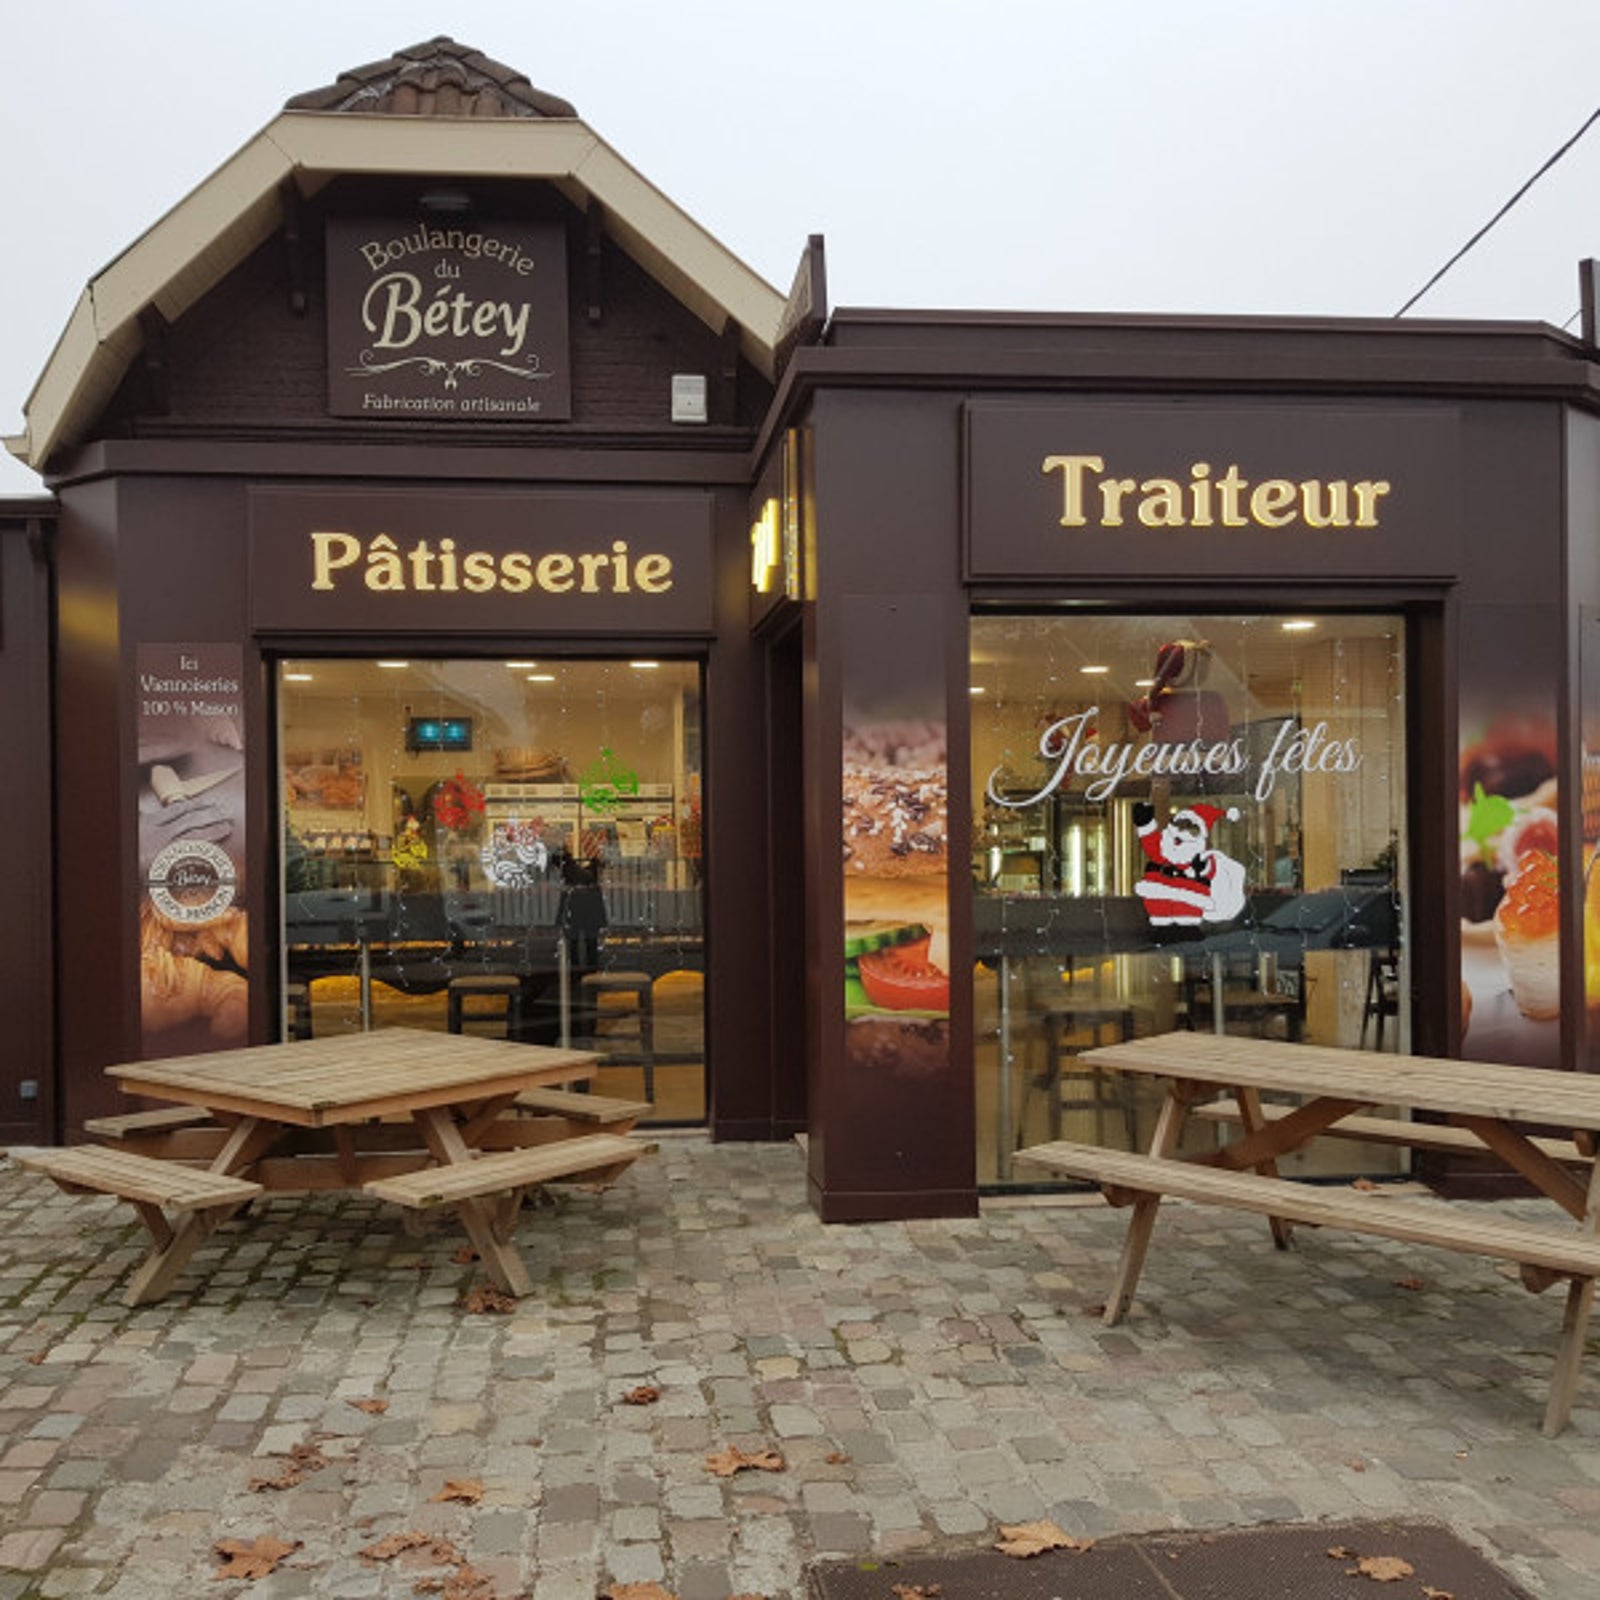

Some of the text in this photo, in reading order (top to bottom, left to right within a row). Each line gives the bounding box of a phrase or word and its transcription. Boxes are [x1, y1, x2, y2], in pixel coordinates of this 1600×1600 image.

[360, 223, 535, 276] Boulangerie
[434, 258, 461, 279] du
[362, 272, 531, 356] Bétey
[362, 393, 541, 412] Fabrication artisanale
[1042, 455, 1391, 527] Traiteur
[310, 532, 673, 593] Pâtisserie
[143, 701, 171, 716] 100
[987, 706, 1362, 808] Joyeuses fêtes
